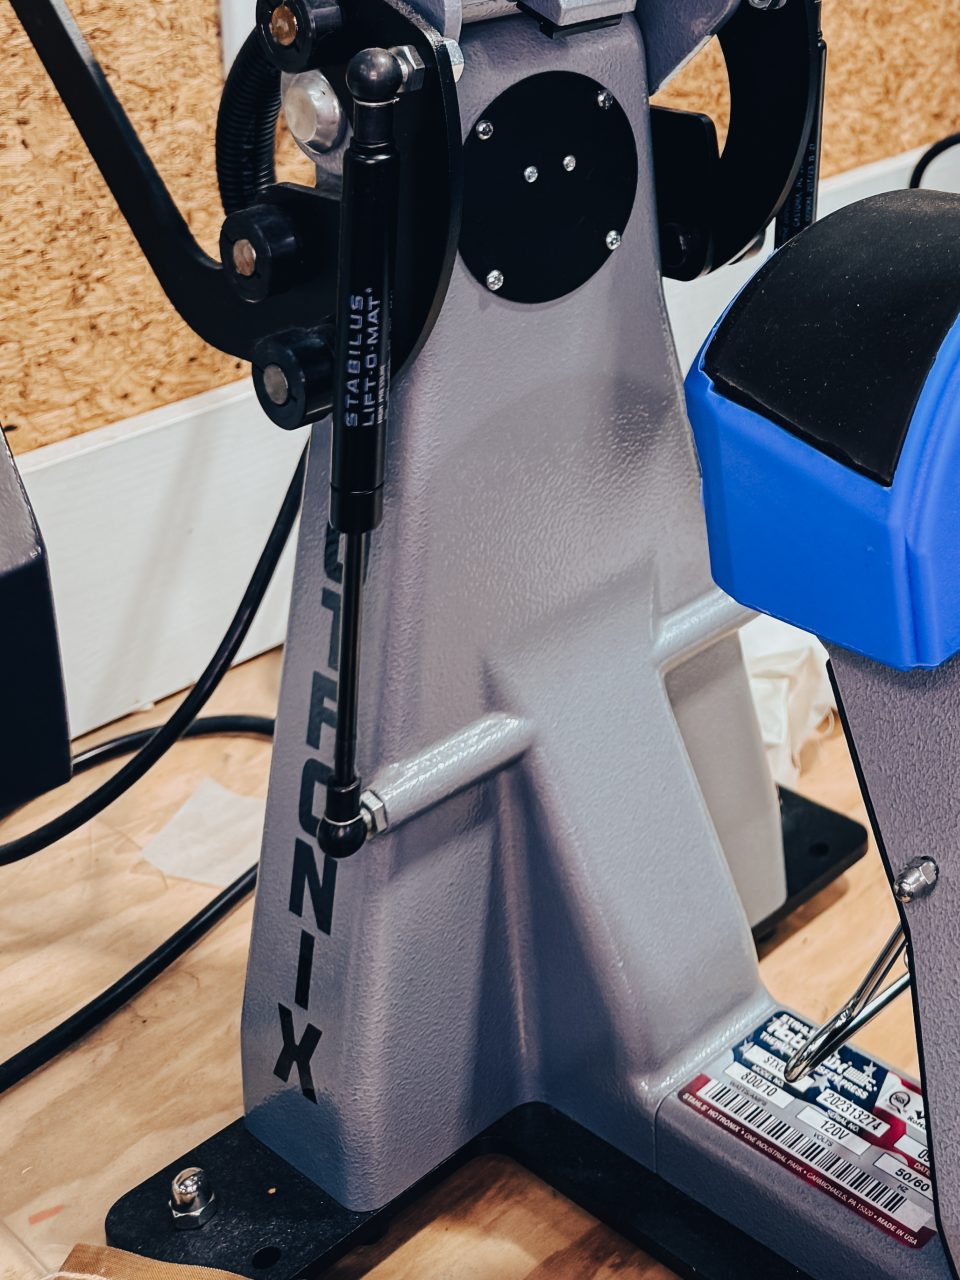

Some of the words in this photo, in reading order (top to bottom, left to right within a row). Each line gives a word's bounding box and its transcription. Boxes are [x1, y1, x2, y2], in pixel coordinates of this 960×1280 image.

[345, 295, 364, 427] STABILUS
[741, 1071, 778, 1098] 800/10
[820, 1120, 850, 1140] 120V
[895, 1168, 930, 1192] 50/60
[813, 1131, 833, 1147] VOLTS
[897, 1184, 909, 1193] HZ
[823, 1092, 882, 1131] 202313274
[744, 1132, 757, 1143] ONE
[756, 1139, 787, 1163] INDUSTRIAL
[787, 1159, 803, 1173] PARK
[847, 1199, 857, 1207] PA
[877, 1216, 898, 1232] MADE
[896, 1228, 905, 1237] IN
[904, 1233, 918, 1245] USA
